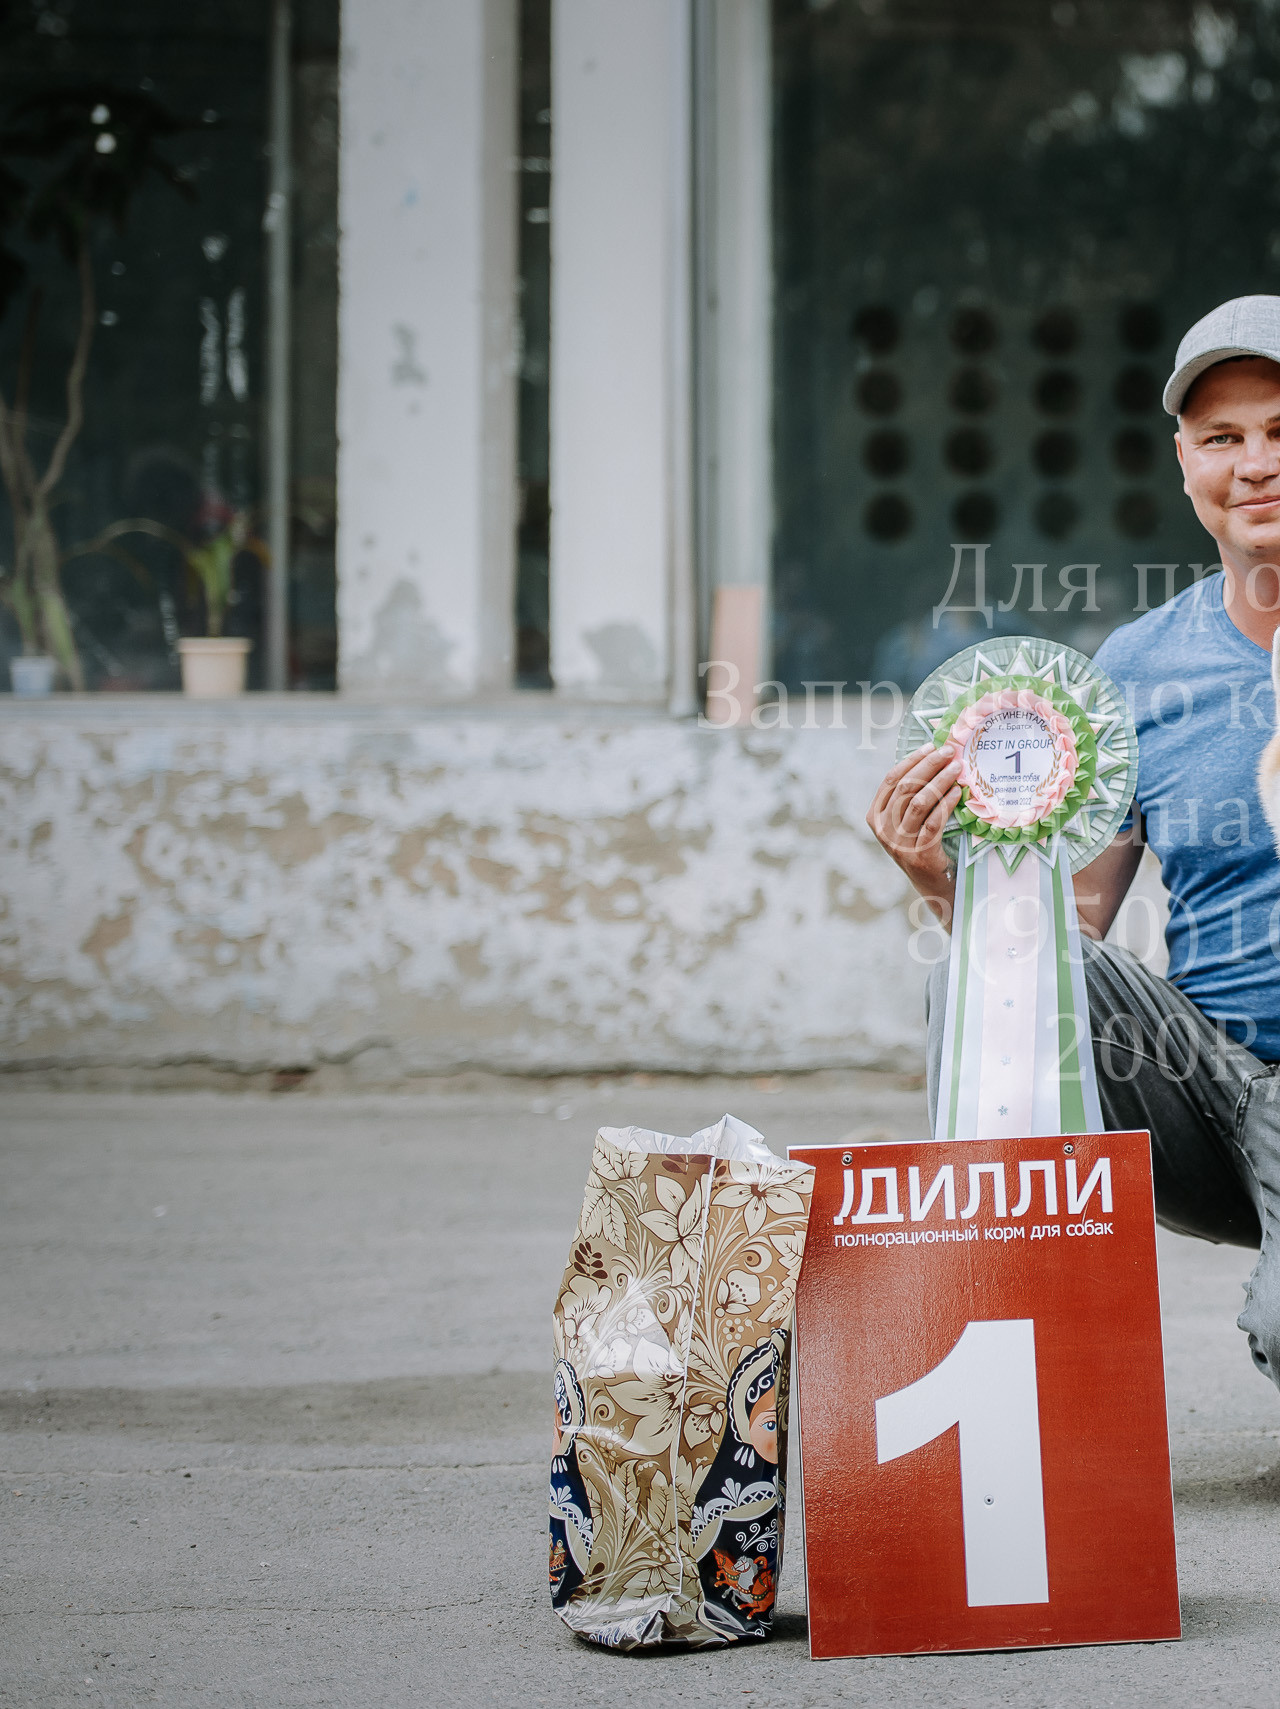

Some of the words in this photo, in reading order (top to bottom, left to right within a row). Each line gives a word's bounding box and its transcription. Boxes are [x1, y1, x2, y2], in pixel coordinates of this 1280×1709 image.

[983, 711, 1048, 733] КОНТИНЕНТАЛЬ
[1006, 722, 1032, 732] Братск
[977, 740, 1004, 750] BEST
[1005, 740, 1015, 750] IN
[1018, 739, 1054, 750] GROUP
[1005, 750, 1021, 774] 1
[834, 1223, 979, 1249] полнорационный
[984, 1224, 1025, 1243] корм
[1030, 1224, 1061, 1241] для
[1066, 1219, 1114, 1237] собак
[875, 1318, 1050, 1608] 1
